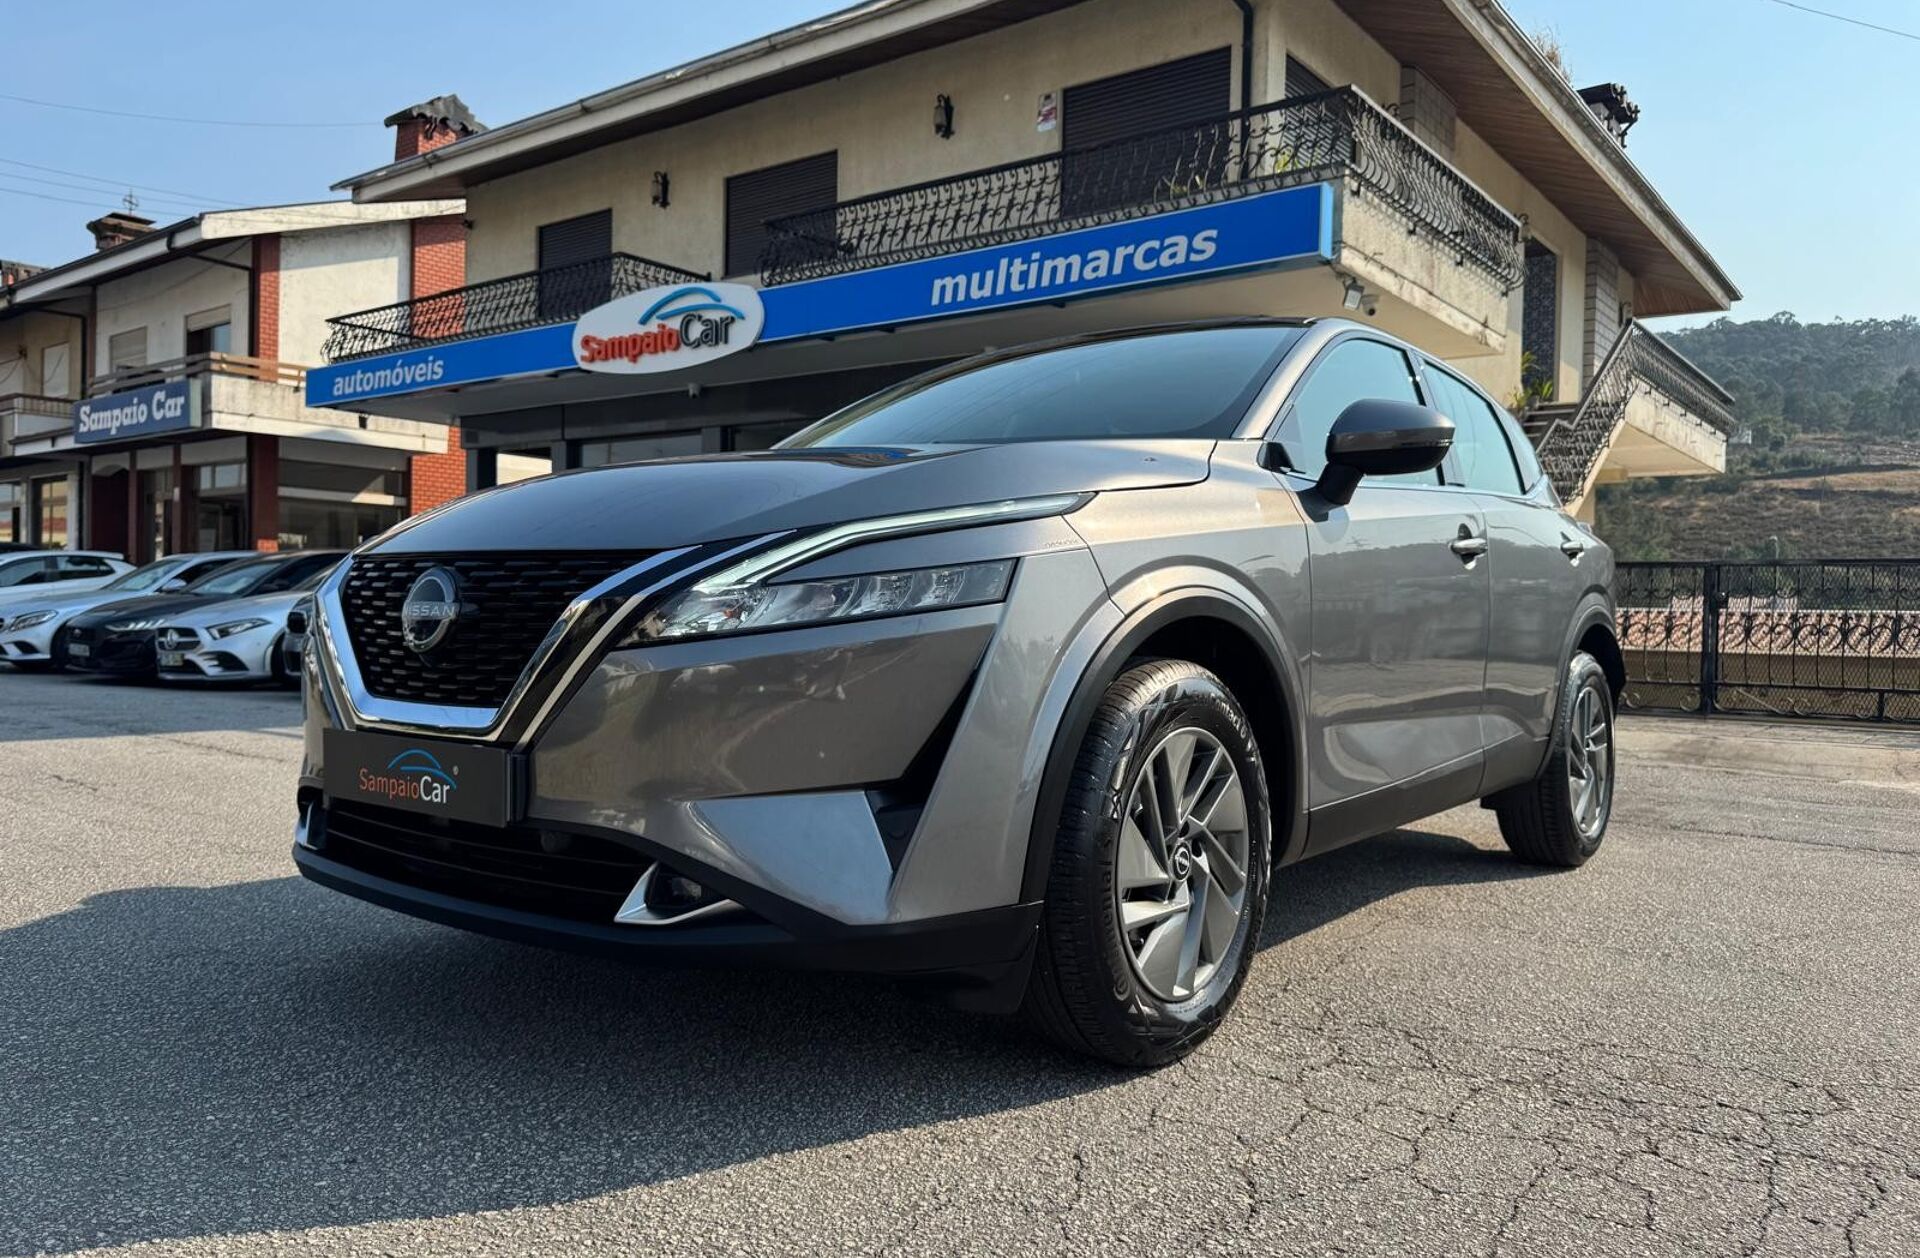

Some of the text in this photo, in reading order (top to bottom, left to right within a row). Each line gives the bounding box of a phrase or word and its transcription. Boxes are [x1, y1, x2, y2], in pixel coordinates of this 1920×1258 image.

[931, 229, 1218, 306] multimarcas
[580, 314, 736, 364] SampaioCar
[333, 356, 444, 396] automóveis
[78, 390, 185, 435] Sampaio Car
[359, 767, 450, 803] SampaioCar
